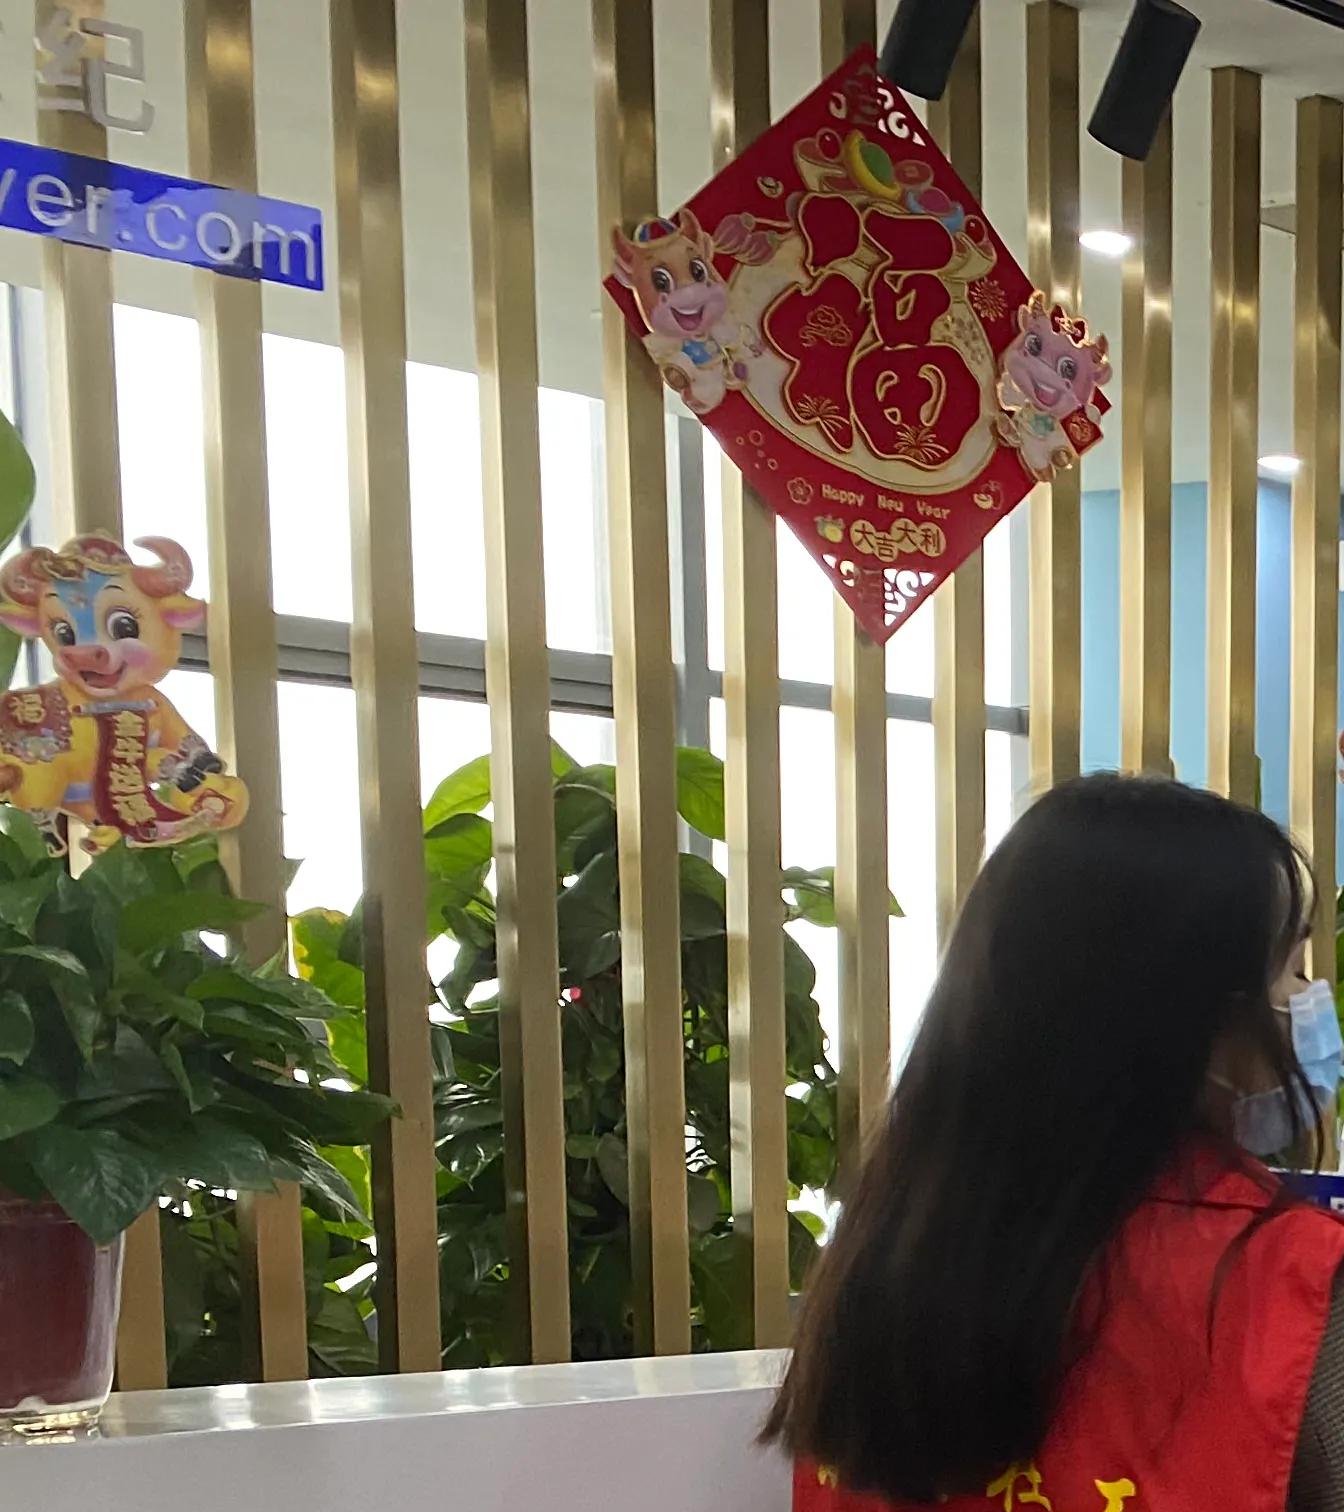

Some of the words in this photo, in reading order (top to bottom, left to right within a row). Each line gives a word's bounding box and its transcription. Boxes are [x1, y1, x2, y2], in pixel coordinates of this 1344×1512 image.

[822, 484, 864, 507] Happy
[916, 501, 951, 519] Year
[854, 522, 942, 558] 大吉大利
